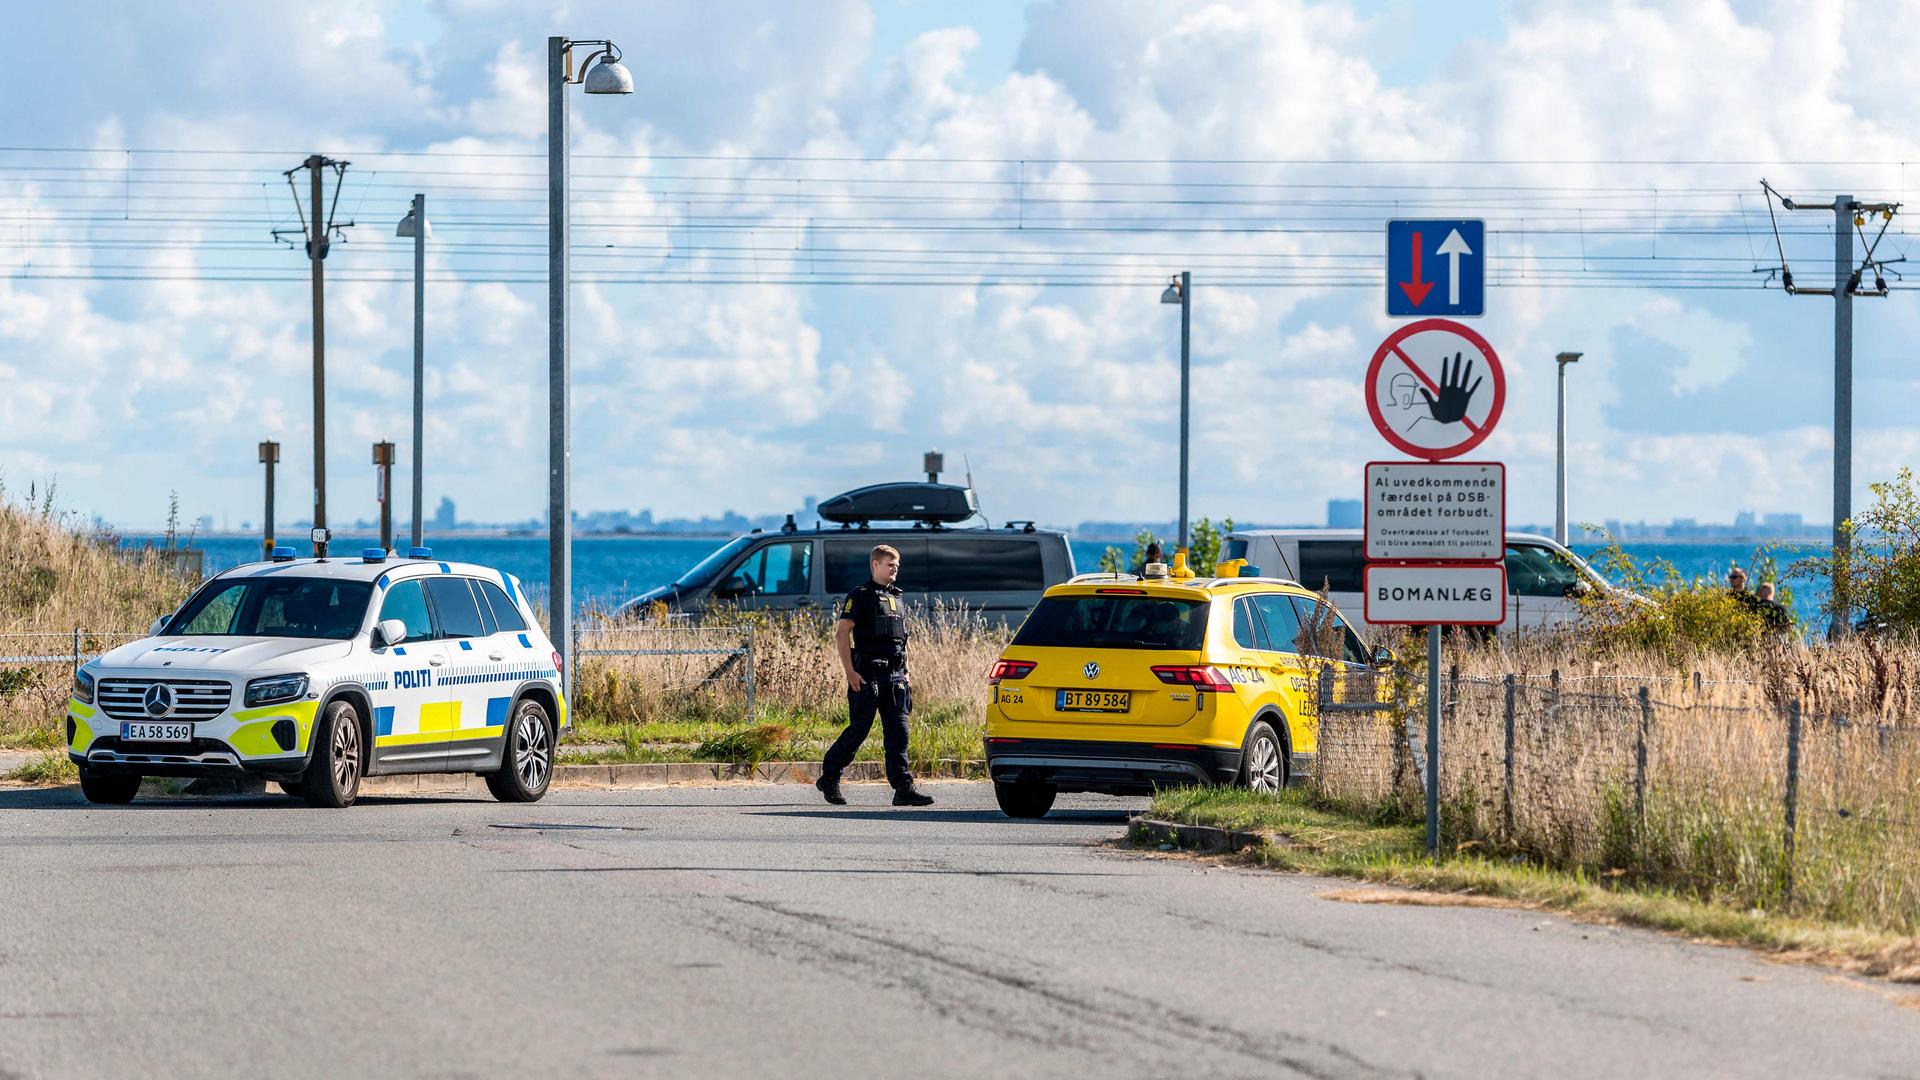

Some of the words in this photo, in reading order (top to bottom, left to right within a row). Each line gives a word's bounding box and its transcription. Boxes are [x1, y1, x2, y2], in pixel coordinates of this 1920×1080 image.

[1375, 477, 1389, 487] Al
[1393, 477, 1496, 487] uvedkommende
[1381, 492, 1432, 502] færdsel
[1437, 492, 1452, 503] på
[1457, 492, 1490, 502] DSB-
[1377, 507, 1432, 517] området
[1438, 507, 1493, 517] forbudt.
[1381, 528, 1438, 536] Overtrædelse
[1441, 528, 1449, 536] af
[1452, 528, 1489, 536] forbudet
[1460, 540, 1495, 548] politiet.
[1378, 587, 1492, 601] BOMANLÆG
[394, 669, 431, 689] POLITI
[1228, 665, 1247, 683] AG
[1246, 666, 1265, 684] 24
[1001, 694, 1011, 704] AG
[1013, 694, 1023, 704] 24
[1065, 692, 1082, 706] BT
[1085, 693, 1101, 707] 89
[1103, 693, 1127, 707] 584
[130, 725, 146, 738] EA
[148, 725, 164, 739] 58
[166, 725, 189, 739] 569
